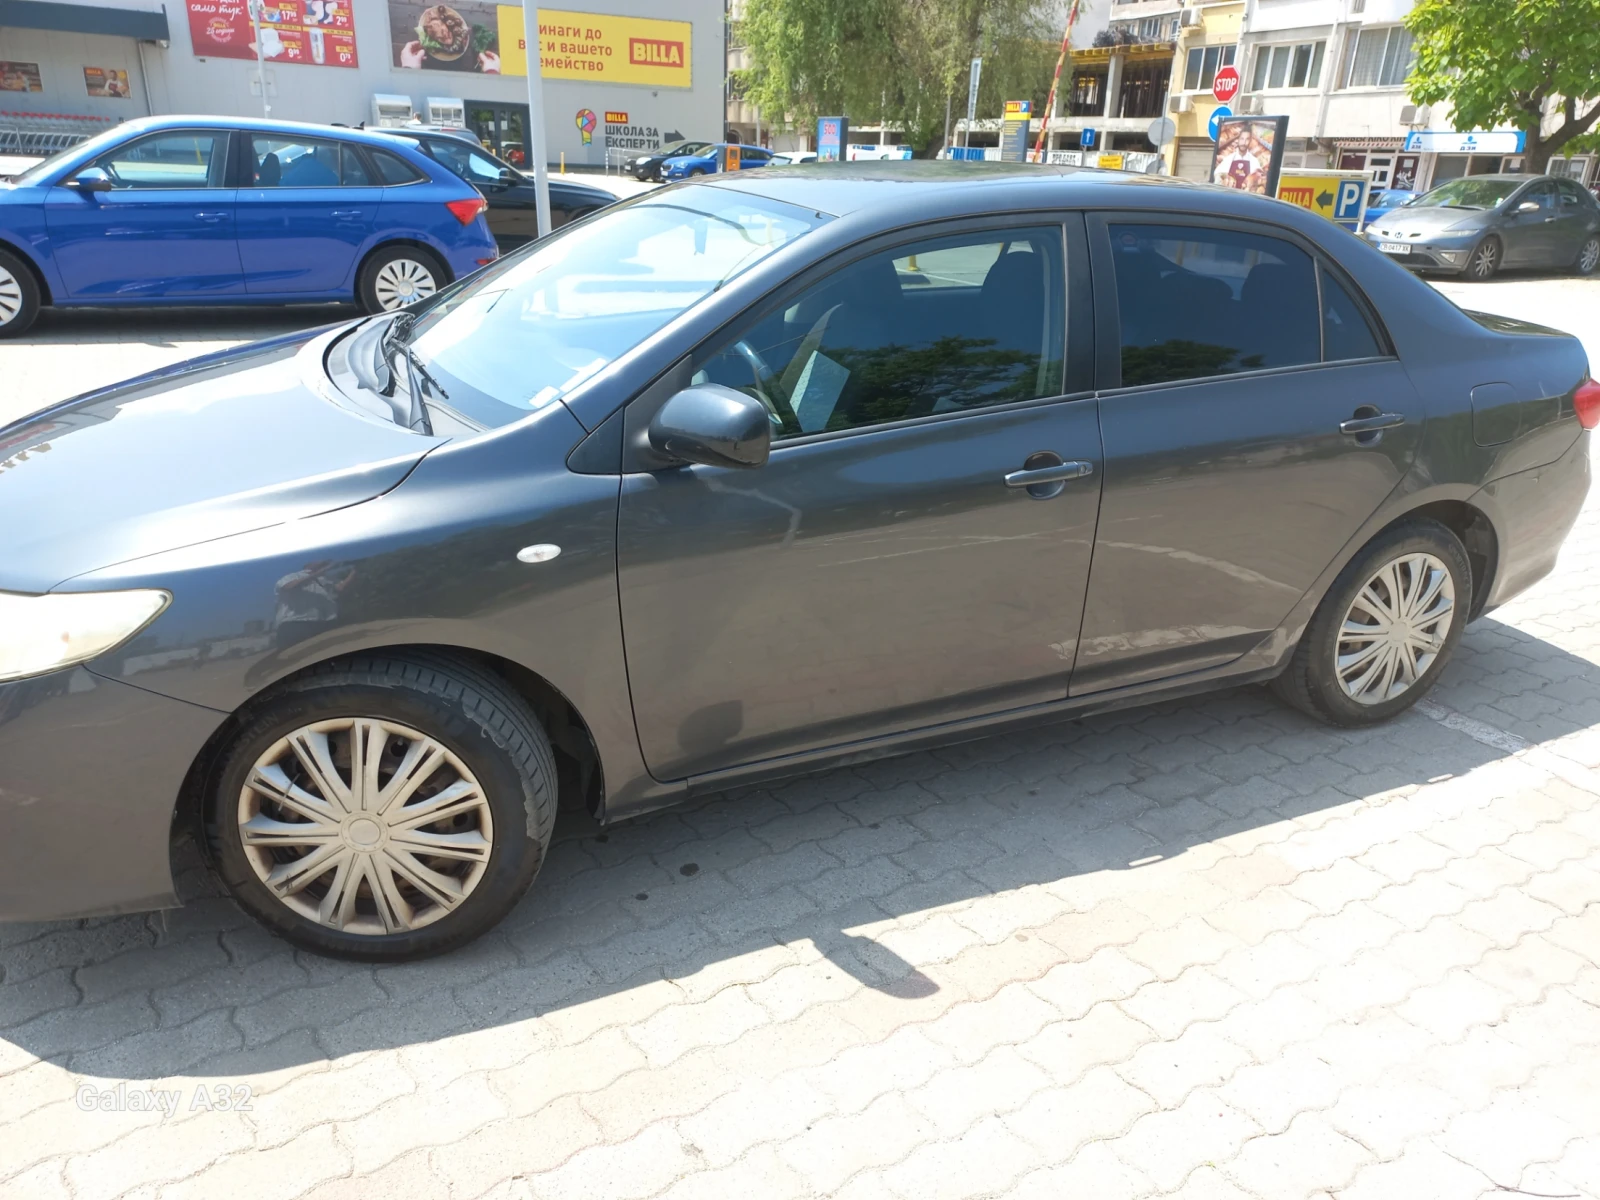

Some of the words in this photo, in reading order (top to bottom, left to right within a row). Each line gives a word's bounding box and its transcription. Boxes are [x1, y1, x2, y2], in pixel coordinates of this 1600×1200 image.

[538, 24, 581, 38] инаги
[585, 29, 602, 41] до
[547, 41, 555, 53] и
[560, 42, 612, 57] вашето
[633, 42, 681, 64] BILLA
[539, 56, 604, 72] емейство
[1216, 77, 1237, 92] STOP
[606, 113, 627, 123] BILLA
[605, 125, 645, 136] ШКОЛА
[646, 127, 659, 138] ЗА
[605, 136, 660, 149] ЕКСПЕРТИ
[1281, 191, 1310, 207] BILLA
[1339, 183, 1360, 217] P
